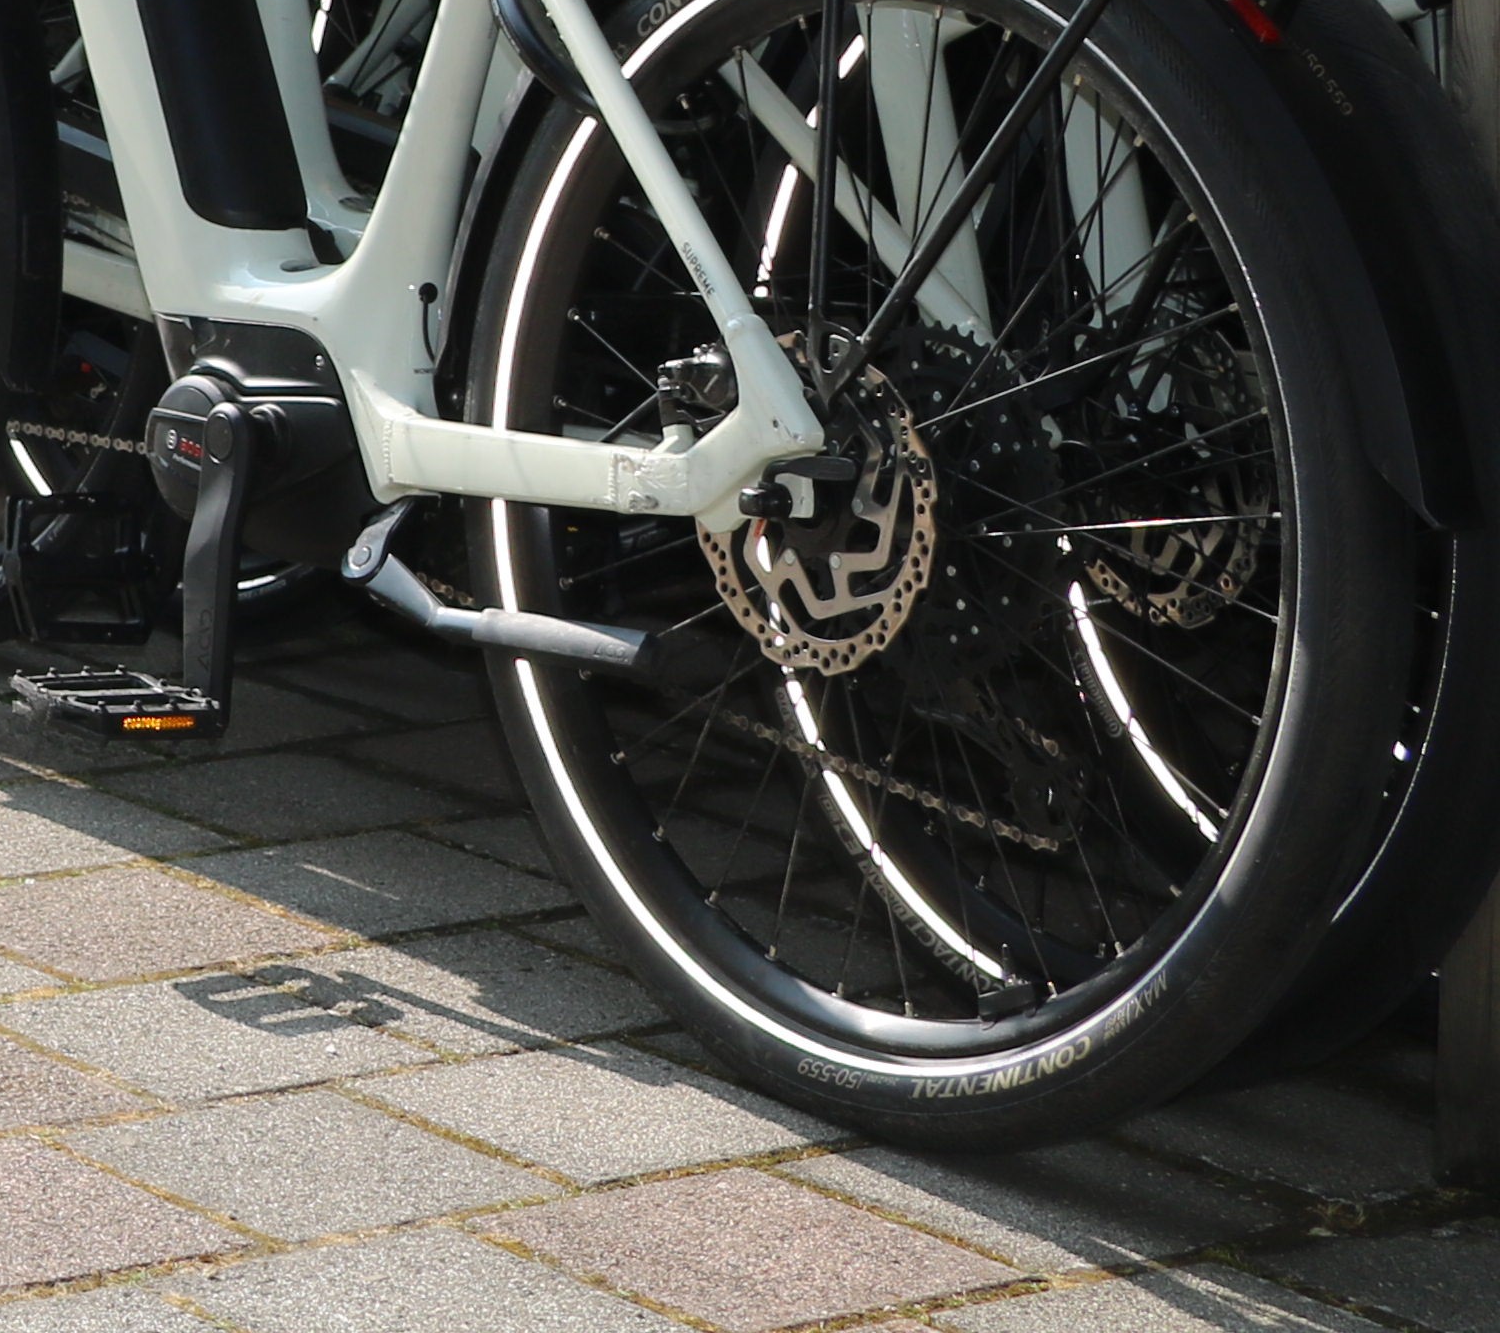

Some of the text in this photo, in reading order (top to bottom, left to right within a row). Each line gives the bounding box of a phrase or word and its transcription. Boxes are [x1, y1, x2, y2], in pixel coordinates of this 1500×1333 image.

[681, 241, 716, 300] SUPREME
[180, 437, 205, 459] BOS
[911, 1035, 1093, 1100] CONTINENTAL
